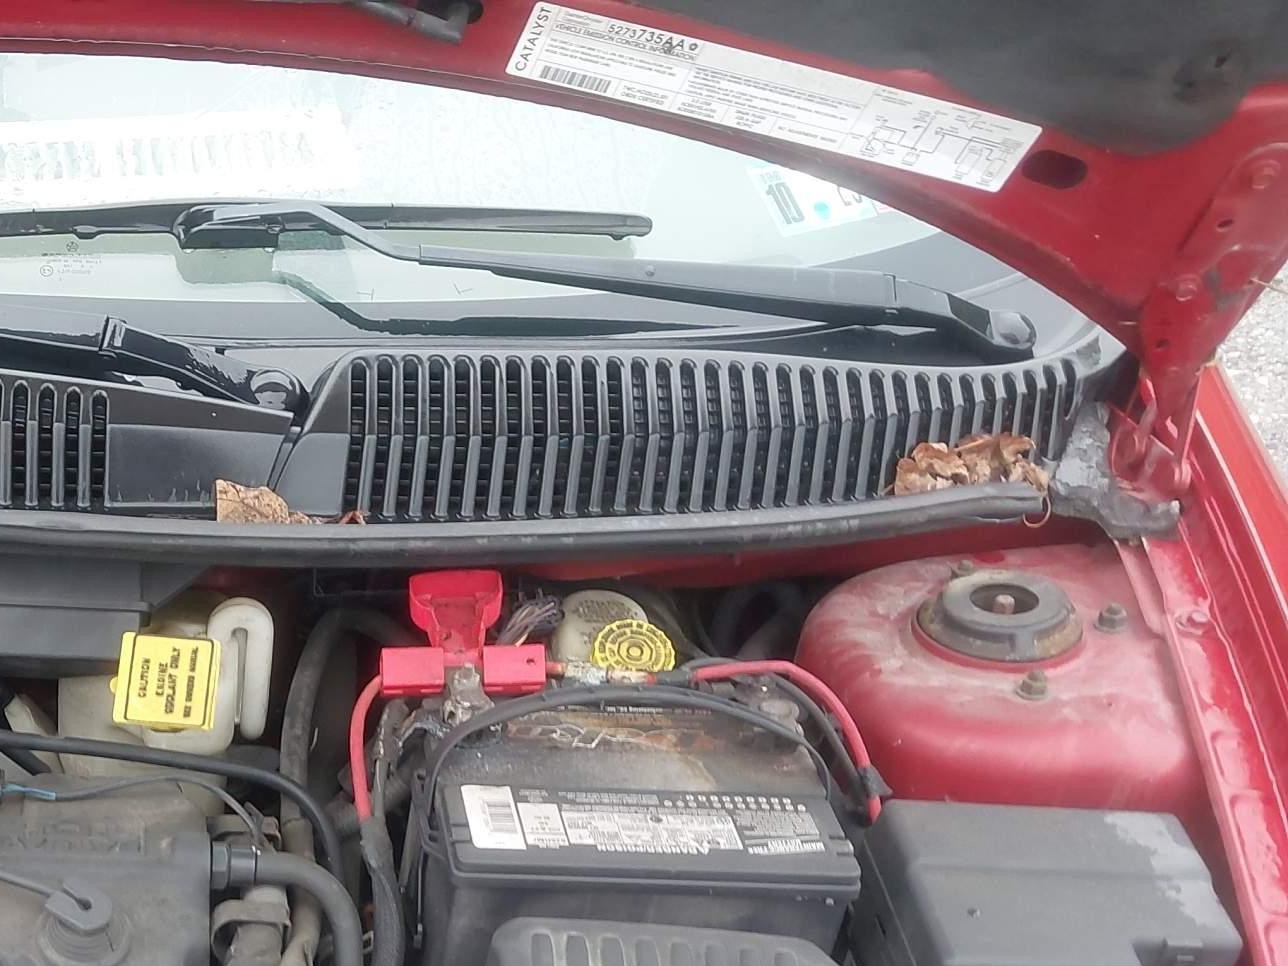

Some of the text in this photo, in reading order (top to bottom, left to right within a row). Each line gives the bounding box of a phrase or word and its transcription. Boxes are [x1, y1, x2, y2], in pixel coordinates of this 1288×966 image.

[515, 6, 552, 71] CATALYST
[608, 24, 685, 51] 5273735AA
[138, 657, 151, 698] CAUTION
